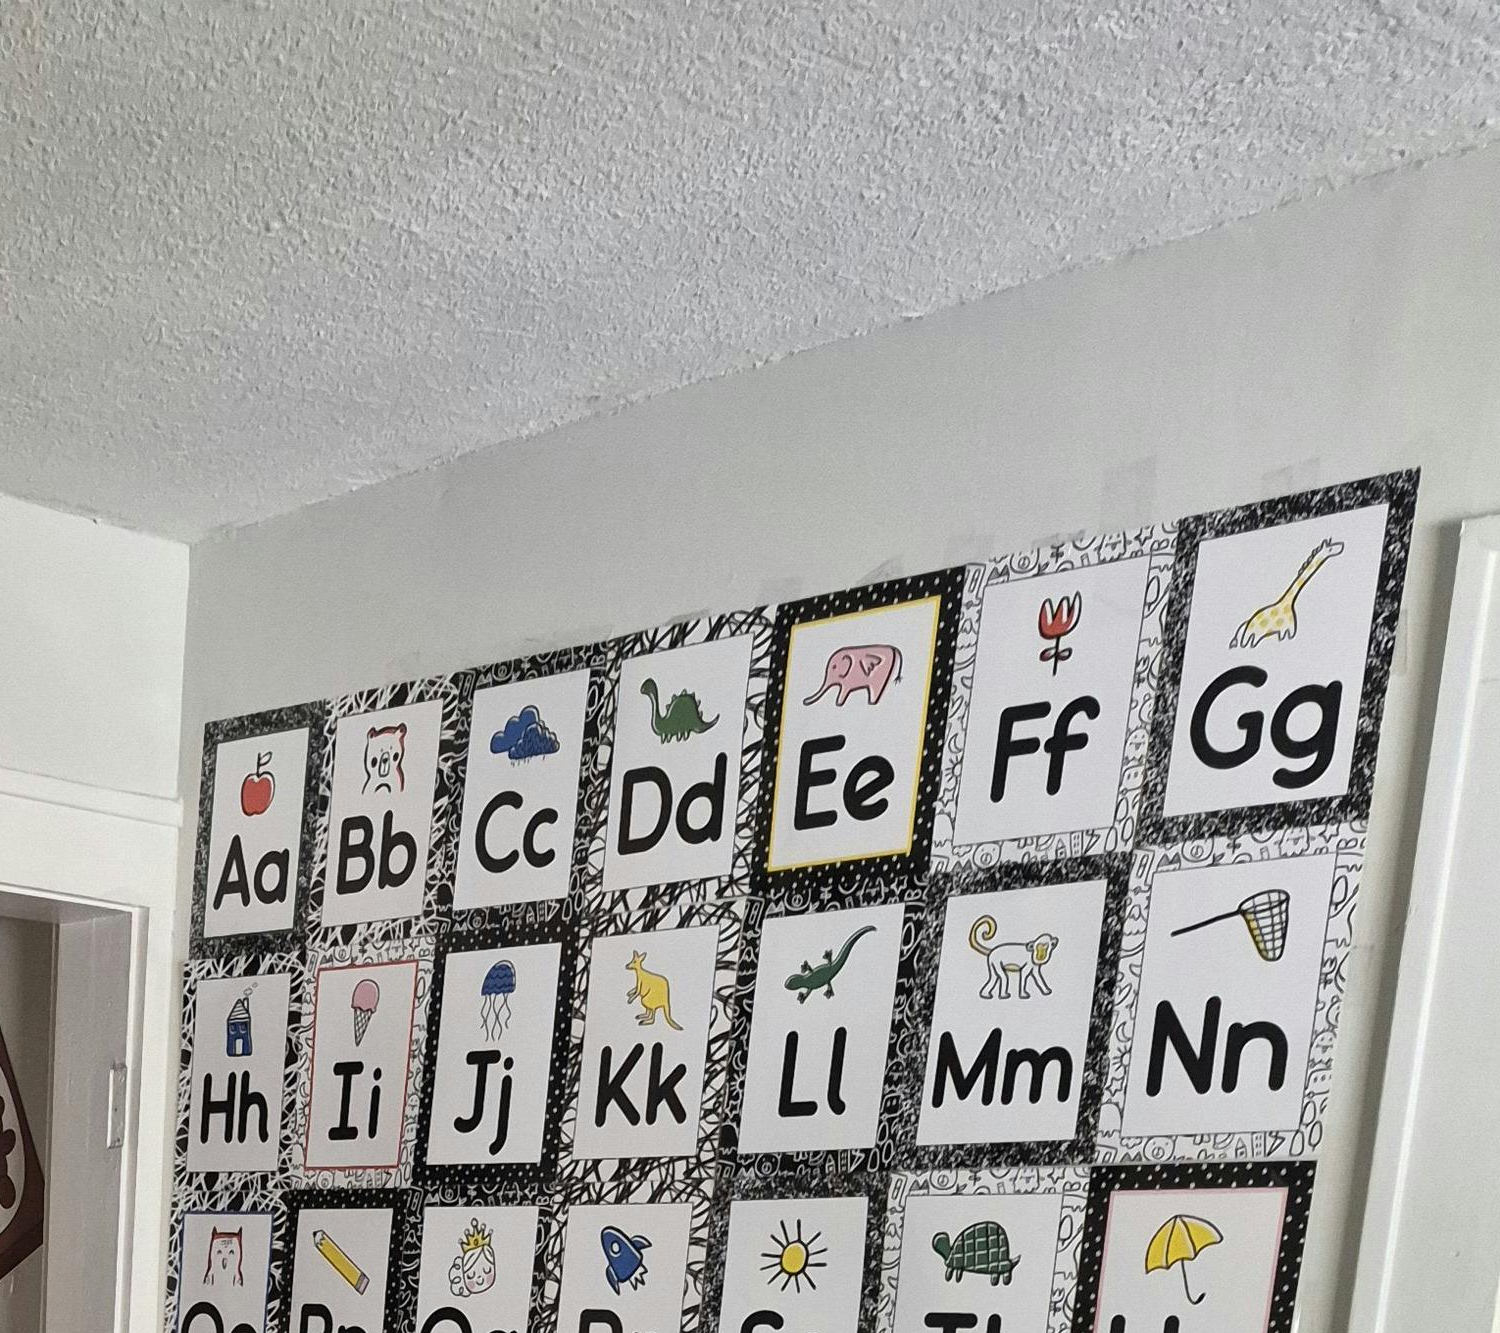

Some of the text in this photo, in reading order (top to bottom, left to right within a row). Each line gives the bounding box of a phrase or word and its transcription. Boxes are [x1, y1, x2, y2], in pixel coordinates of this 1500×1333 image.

[990, 696, 1100, 803] Ff
[1189, 665, 1343, 790] Gg
[617, 752, 728, 856] Dd
[793, 735, 895, 829] Ee
[213, 835, 290, 909] Aa
[336, 810, 418, 895] Bb
[475, 791, 559, 873] Cc
[595, 1042, 687, 1127] Kk
[778, 1027, 846, 1117] Ll
[932, 1028, 1073, 1108] Mm
[1146, 996, 1288, 1096] Nn
[200, 1071, 269, 1144] Hh
[328, 1061, 382, 1139] Ii
[453, 1050, 514, 1154] Jj
